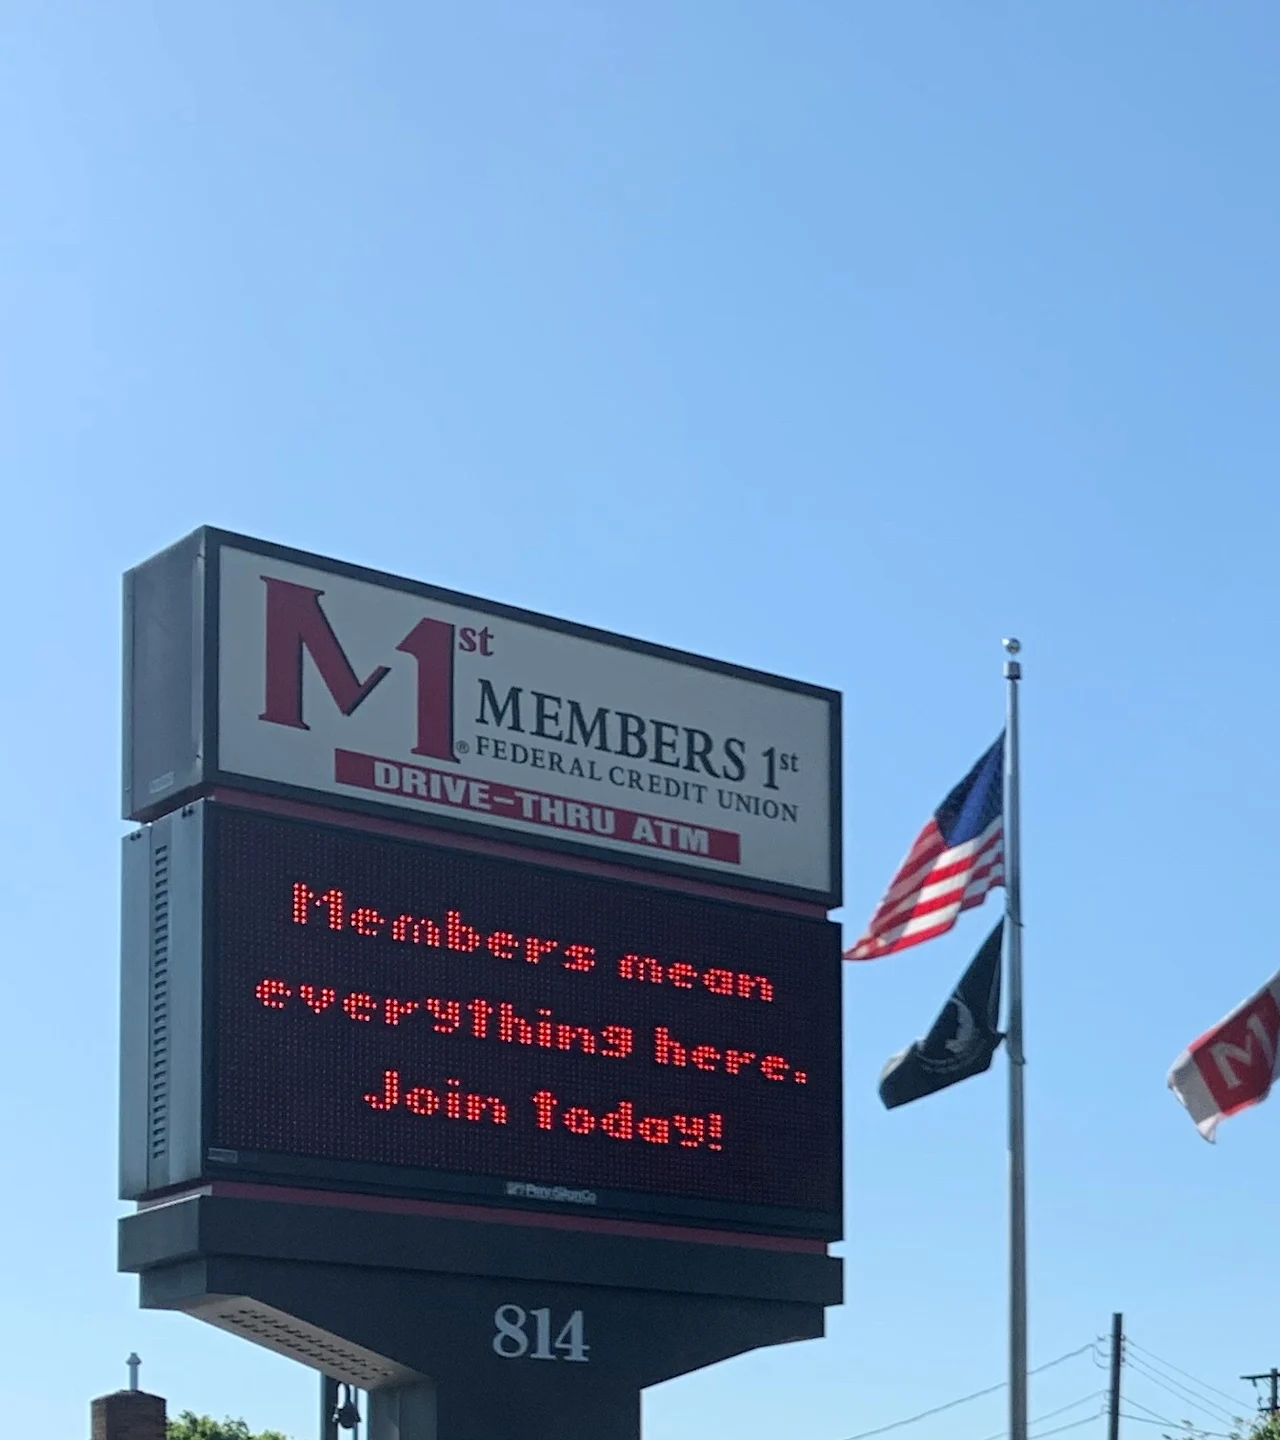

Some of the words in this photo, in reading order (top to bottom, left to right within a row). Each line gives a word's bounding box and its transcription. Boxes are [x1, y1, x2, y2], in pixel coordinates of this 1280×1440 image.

[475, 678, 746, 783] MEMBERS
[762, 746, 800, 791] 1st
[475, 735, 603, 782] FEDERAL
[608, 765, 709, 804] CREDIT
[717, 788, 798, 823] UNION
[373, 760, 616, 835] DRIVE-THRU
[631, 817, 710, 854] ATM
[293, 881, 596, 972] Members
[617, 954, 774, 1002] mean
[255, 979, 634, 1059] everything
[655, 1026, 807, 1085] here.
[363, 1070, 507, 1125] Join
[531, 1090, 723, 1151] today!
[492, 1303, 590, 1362] 814
